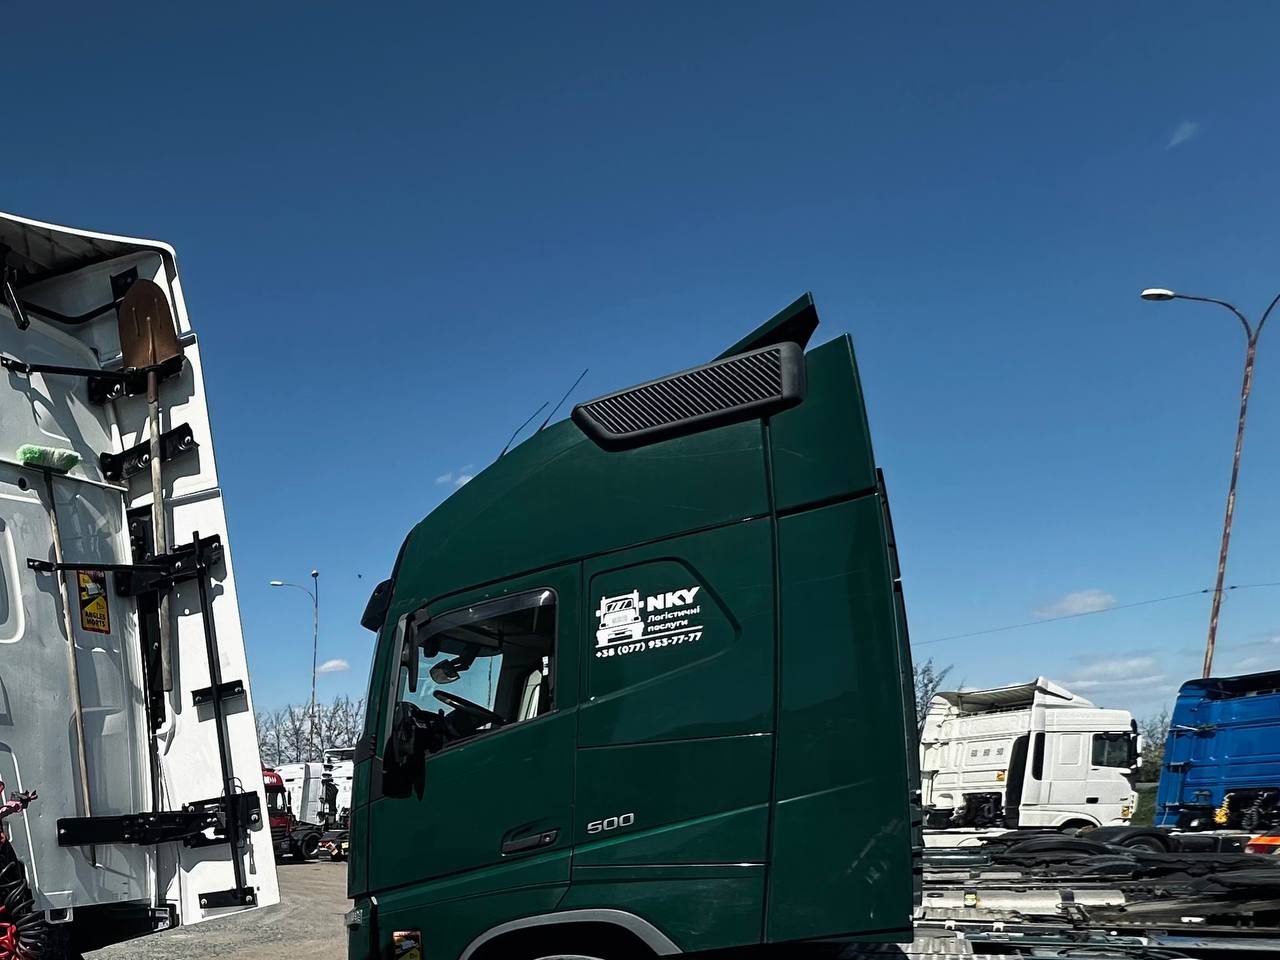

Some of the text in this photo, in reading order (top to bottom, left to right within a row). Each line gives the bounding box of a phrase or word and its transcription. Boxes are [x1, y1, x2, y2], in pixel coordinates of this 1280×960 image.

[646, 586, 700, 612] NKY
[647, 606, 700, 623] Логістичні
[647, 620, 688, 632] послуги
[595, 632, 702, 658] +38 (077) 953-77-77
[587, 813, 634, 834] 500
